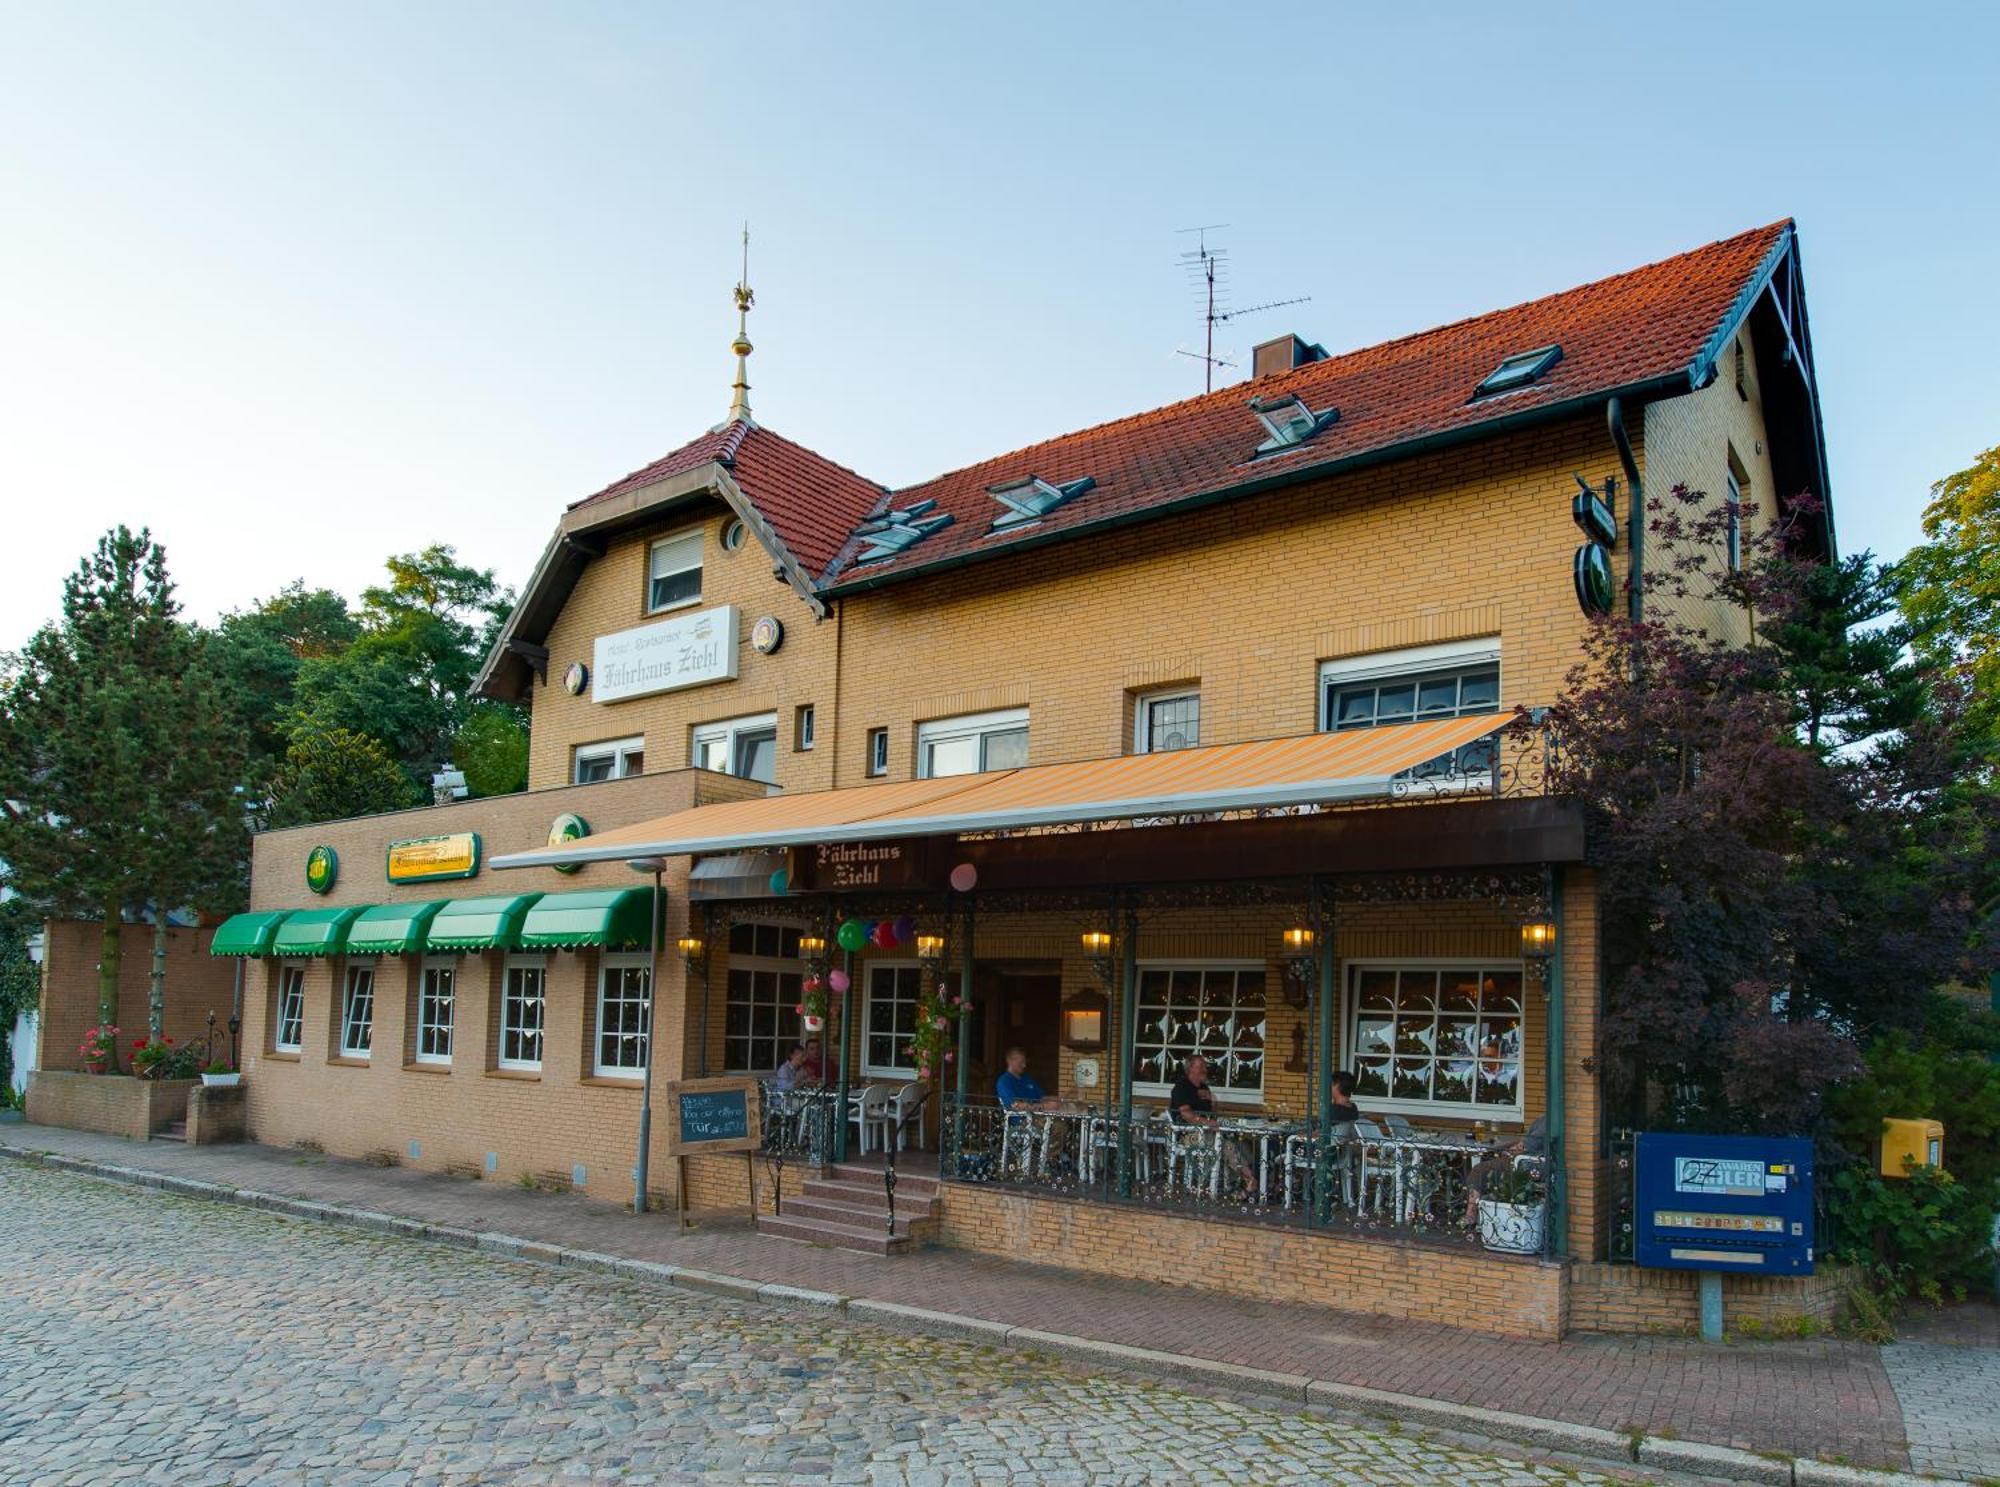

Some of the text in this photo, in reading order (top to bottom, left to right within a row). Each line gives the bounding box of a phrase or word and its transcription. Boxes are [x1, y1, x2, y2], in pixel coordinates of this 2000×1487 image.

[678, 641, 719, 673] Ziehl
[816, 842, 901, 867] Fährhaus
[833, 864, 879, 887] Ziehl
